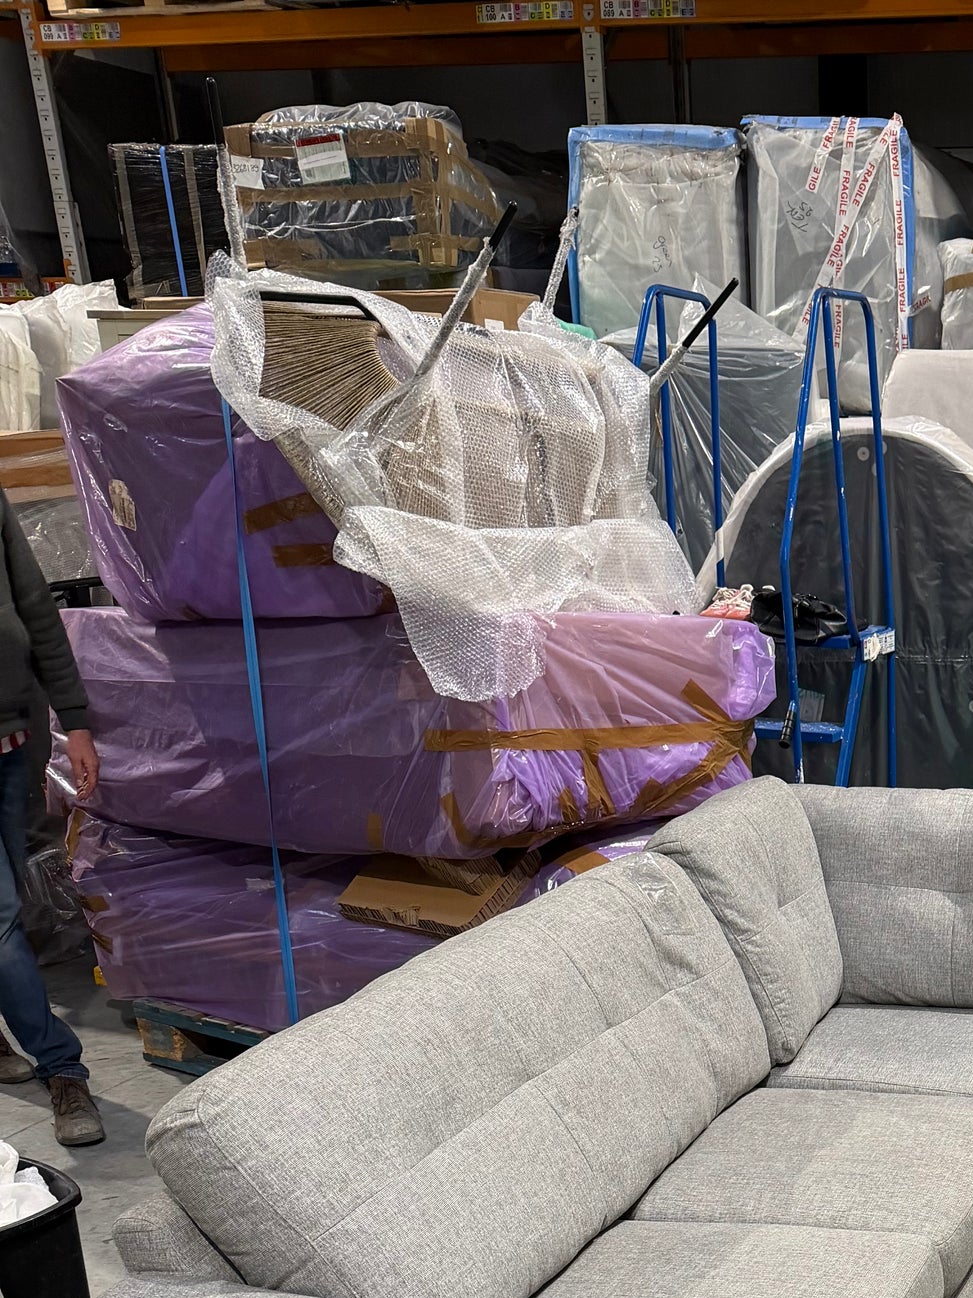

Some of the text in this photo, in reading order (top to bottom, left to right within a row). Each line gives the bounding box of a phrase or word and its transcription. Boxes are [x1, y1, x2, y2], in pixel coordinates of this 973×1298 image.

[839, 170, 850, 216] FRAGILE
[852, 162, 875, 207] FRAGILE
[827, 224, 849, 267] FRAGILE
[896, 200, 904, 246] FRAGILE
